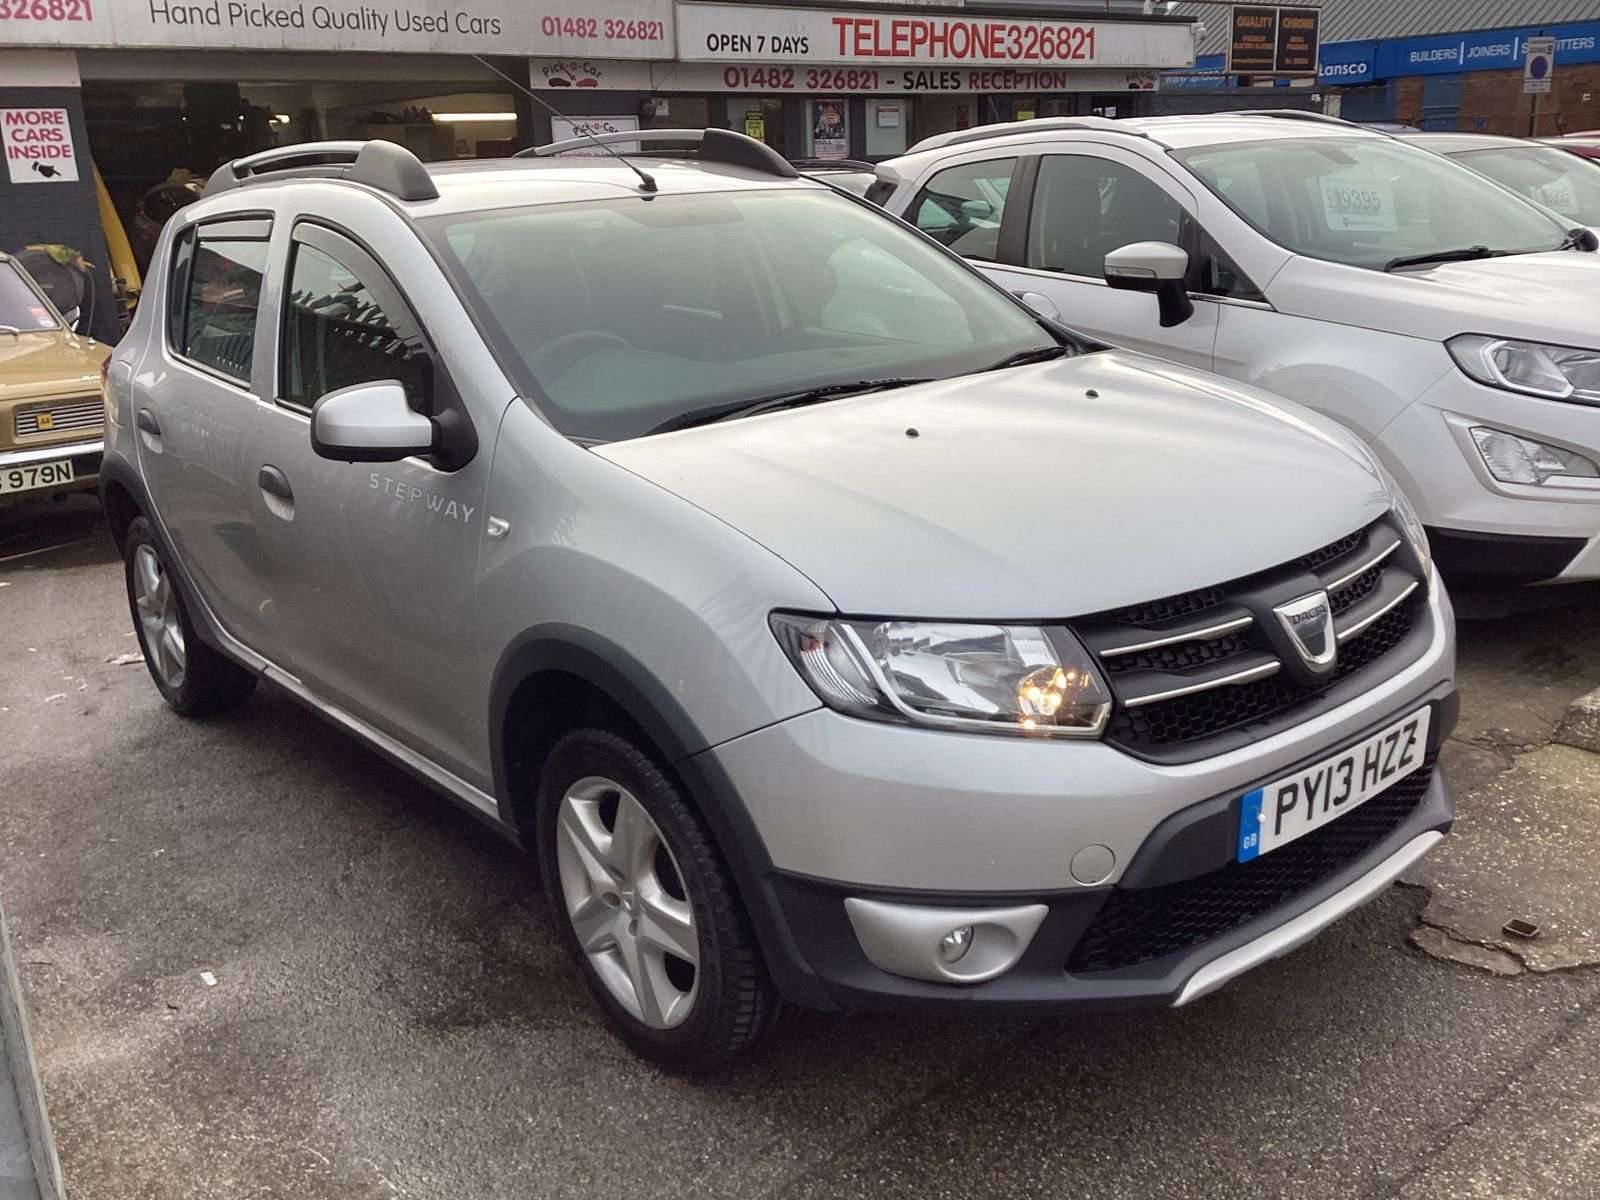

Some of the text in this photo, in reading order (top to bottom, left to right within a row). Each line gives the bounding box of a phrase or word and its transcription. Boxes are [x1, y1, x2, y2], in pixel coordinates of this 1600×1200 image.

[0, 0, 93, 21] 326821
[150, 0, 501, 37] Hand Picked Quality Used Cars
[542, 16, 664, 40] 01482 326821
[706, 33, 809, 54] OPEN 7 DAYS
[1410, 48, 1458, 62] BUILDERS
[1467, 44, 1511, 58] JOINERS
[724, 66, 795, 88] 01482
[806, 69, 879, 90] 326821
[903, 71, 961, 90] SALES
[969, 71, 1067, 90] RECEPTION
[1319, 61, 1368, 77] Lansco
[5, 111, 64, 126] MORE
[11, 128, 63, 142] CARS
[8, 144, 72, 159] INSIDE
[9, 462, 72, 489] 979N
[368, 473, 475, 523] STEPWAY
[1274, 719, 1418, 836] PY13 HZZ
[1243, 833, 1257, 849] GB
